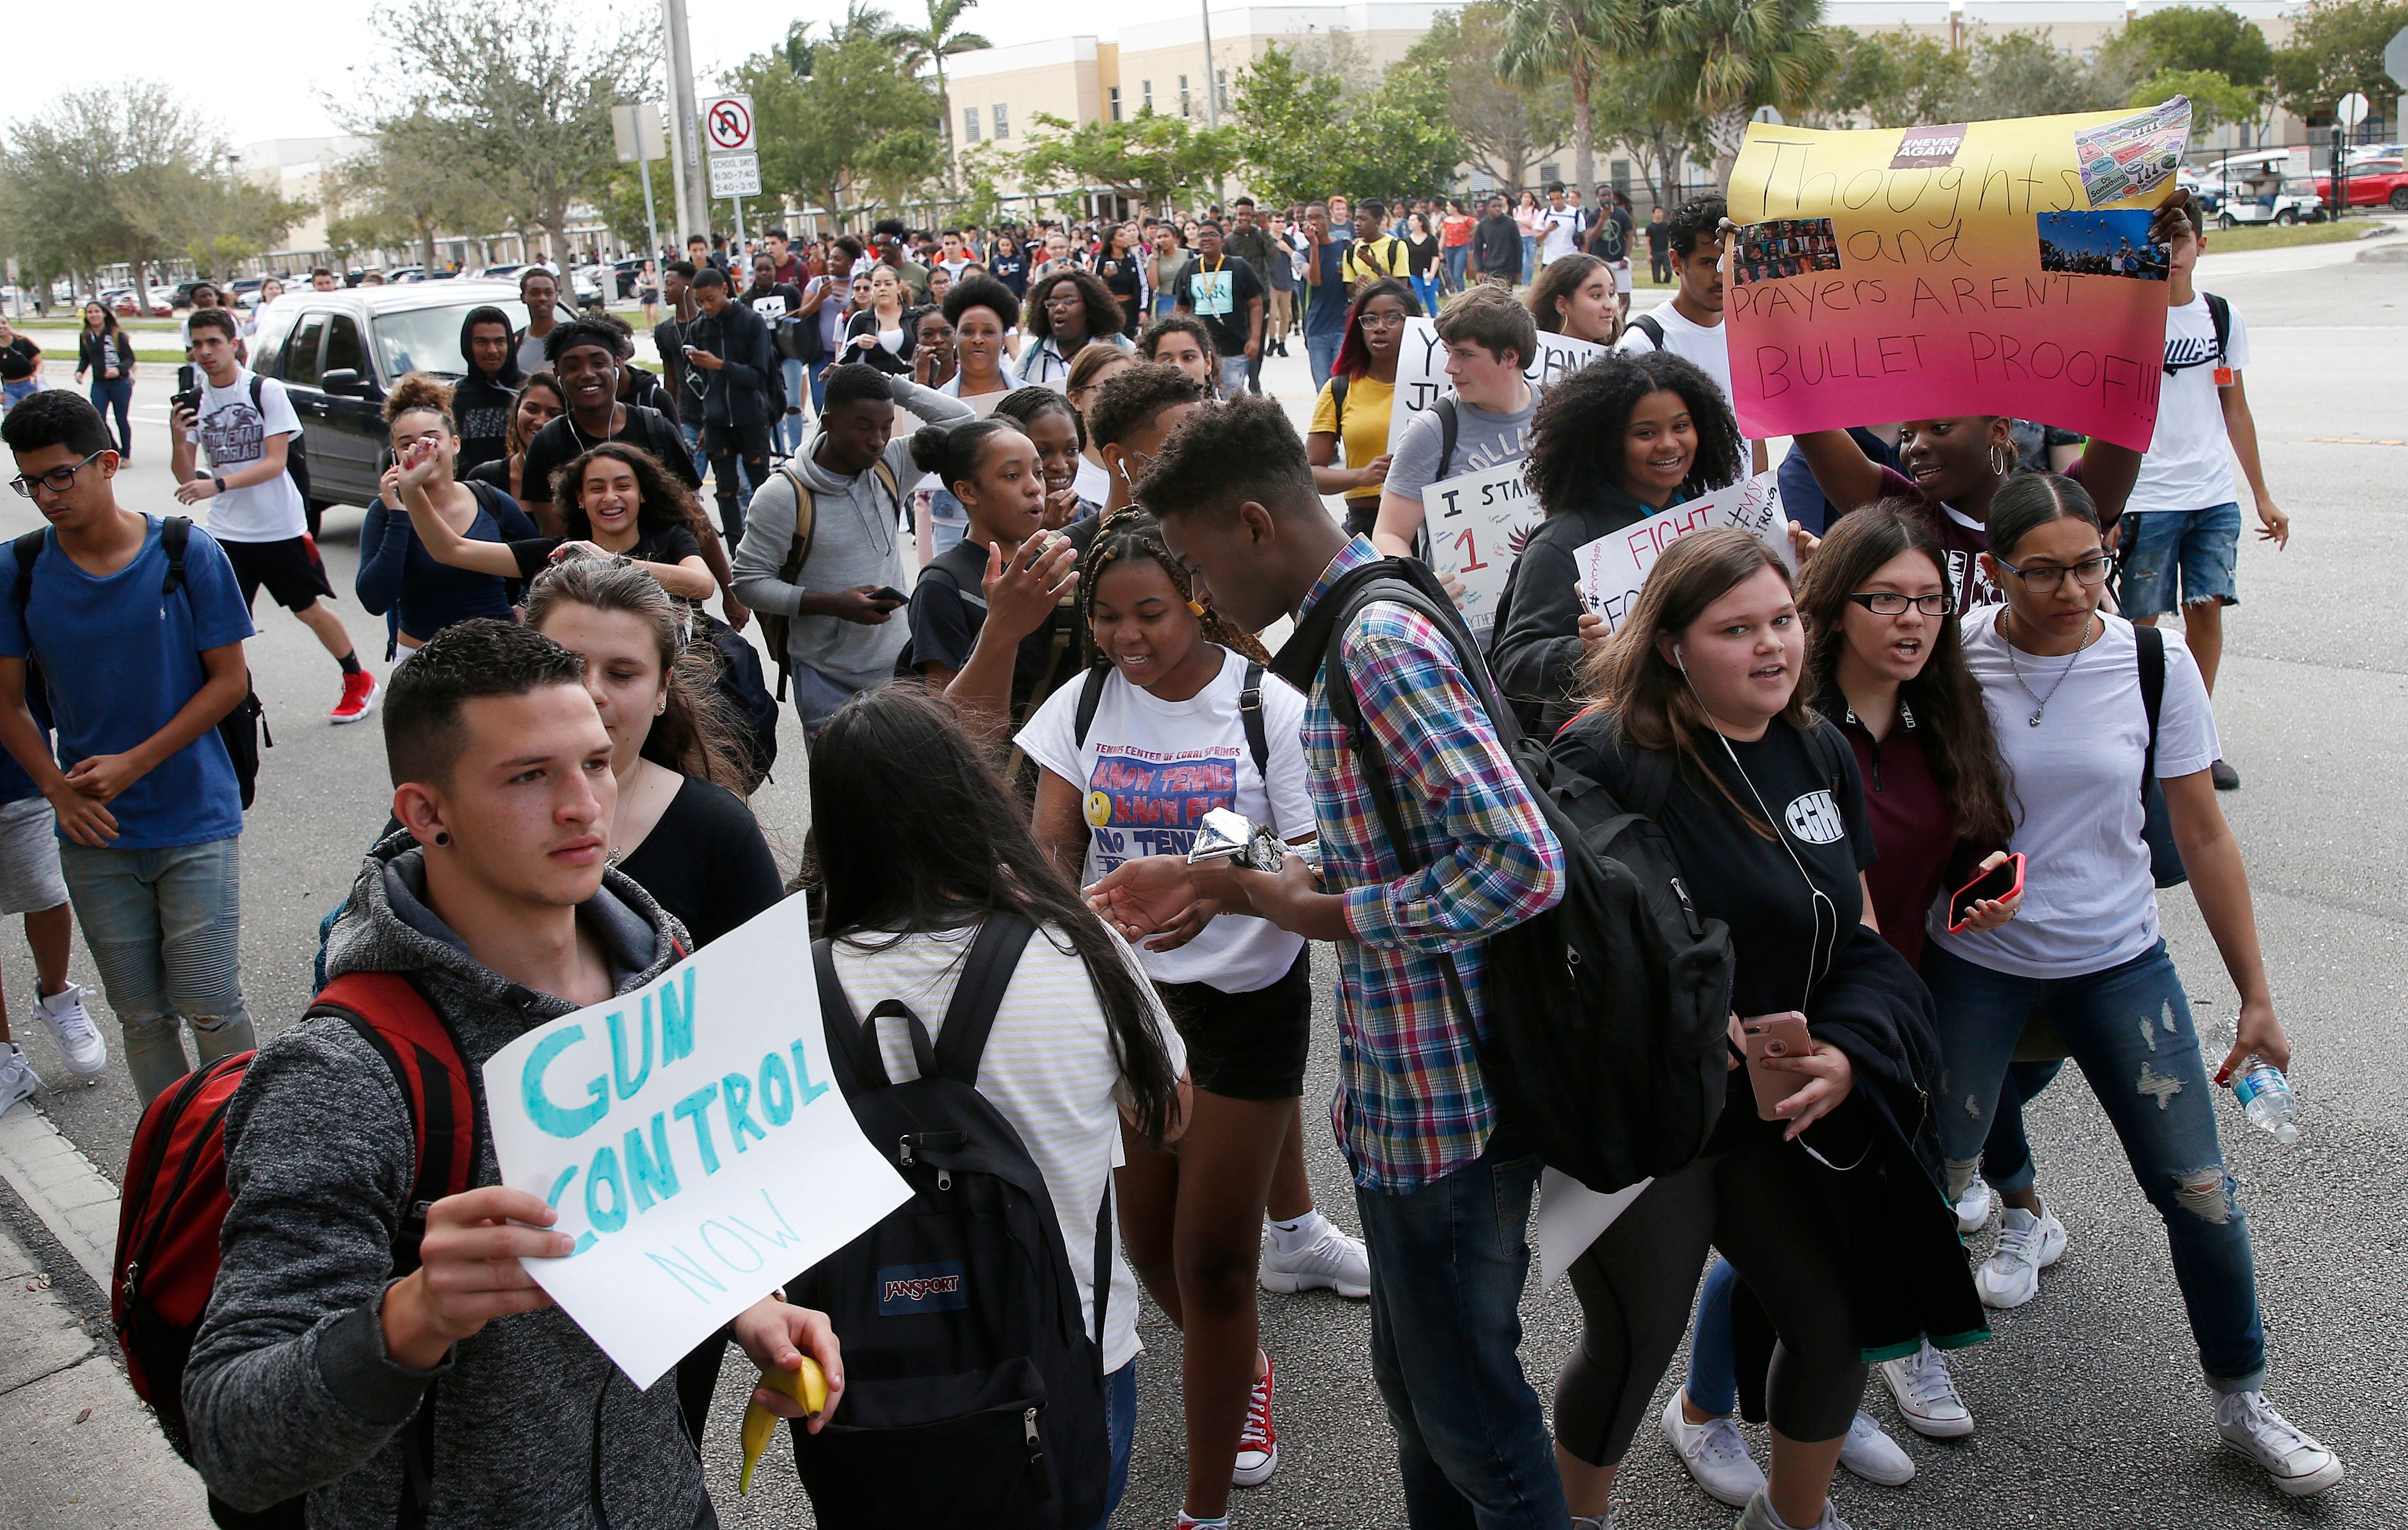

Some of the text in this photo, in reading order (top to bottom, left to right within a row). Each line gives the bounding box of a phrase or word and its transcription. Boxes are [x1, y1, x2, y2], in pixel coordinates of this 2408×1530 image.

[713, 158, 737, 168] SCHOOL
[1897, 145, 1956, 157] AGAIN
[1902, 137, 1960, 147] #NEVER
[1753, 139, 2081, 229] Thoughts
[2091, 174, 2125, 197] Something
[2101, 176, 2111, 184] Do
[1847, 218, 1972, 267] and
[1911, 273, 2086, 319] AREN'T
[1756, 333, 1927, 400] BULLET
[1442, 489, 1462, 518] I
[1454, 528, 1488, 573] 1
[1627, 504, 1715, 571] FIGHT
[1589, 542, 1602, 610] #NeverAgain
[1095, 742, 1240, 761] TENNIS CENTER OF CORAL SPRINGS
[1160, 764, 1234, 792] TENNIS
[1787, 792, 1843, 842] CGH
[521, 966, 696, 1140] GUN
[545, 1038, 830, 1257] CONTROL
[644, 1188, 801, 1305] NOW
[884, 1275, 959, 1302] JANSPORT
